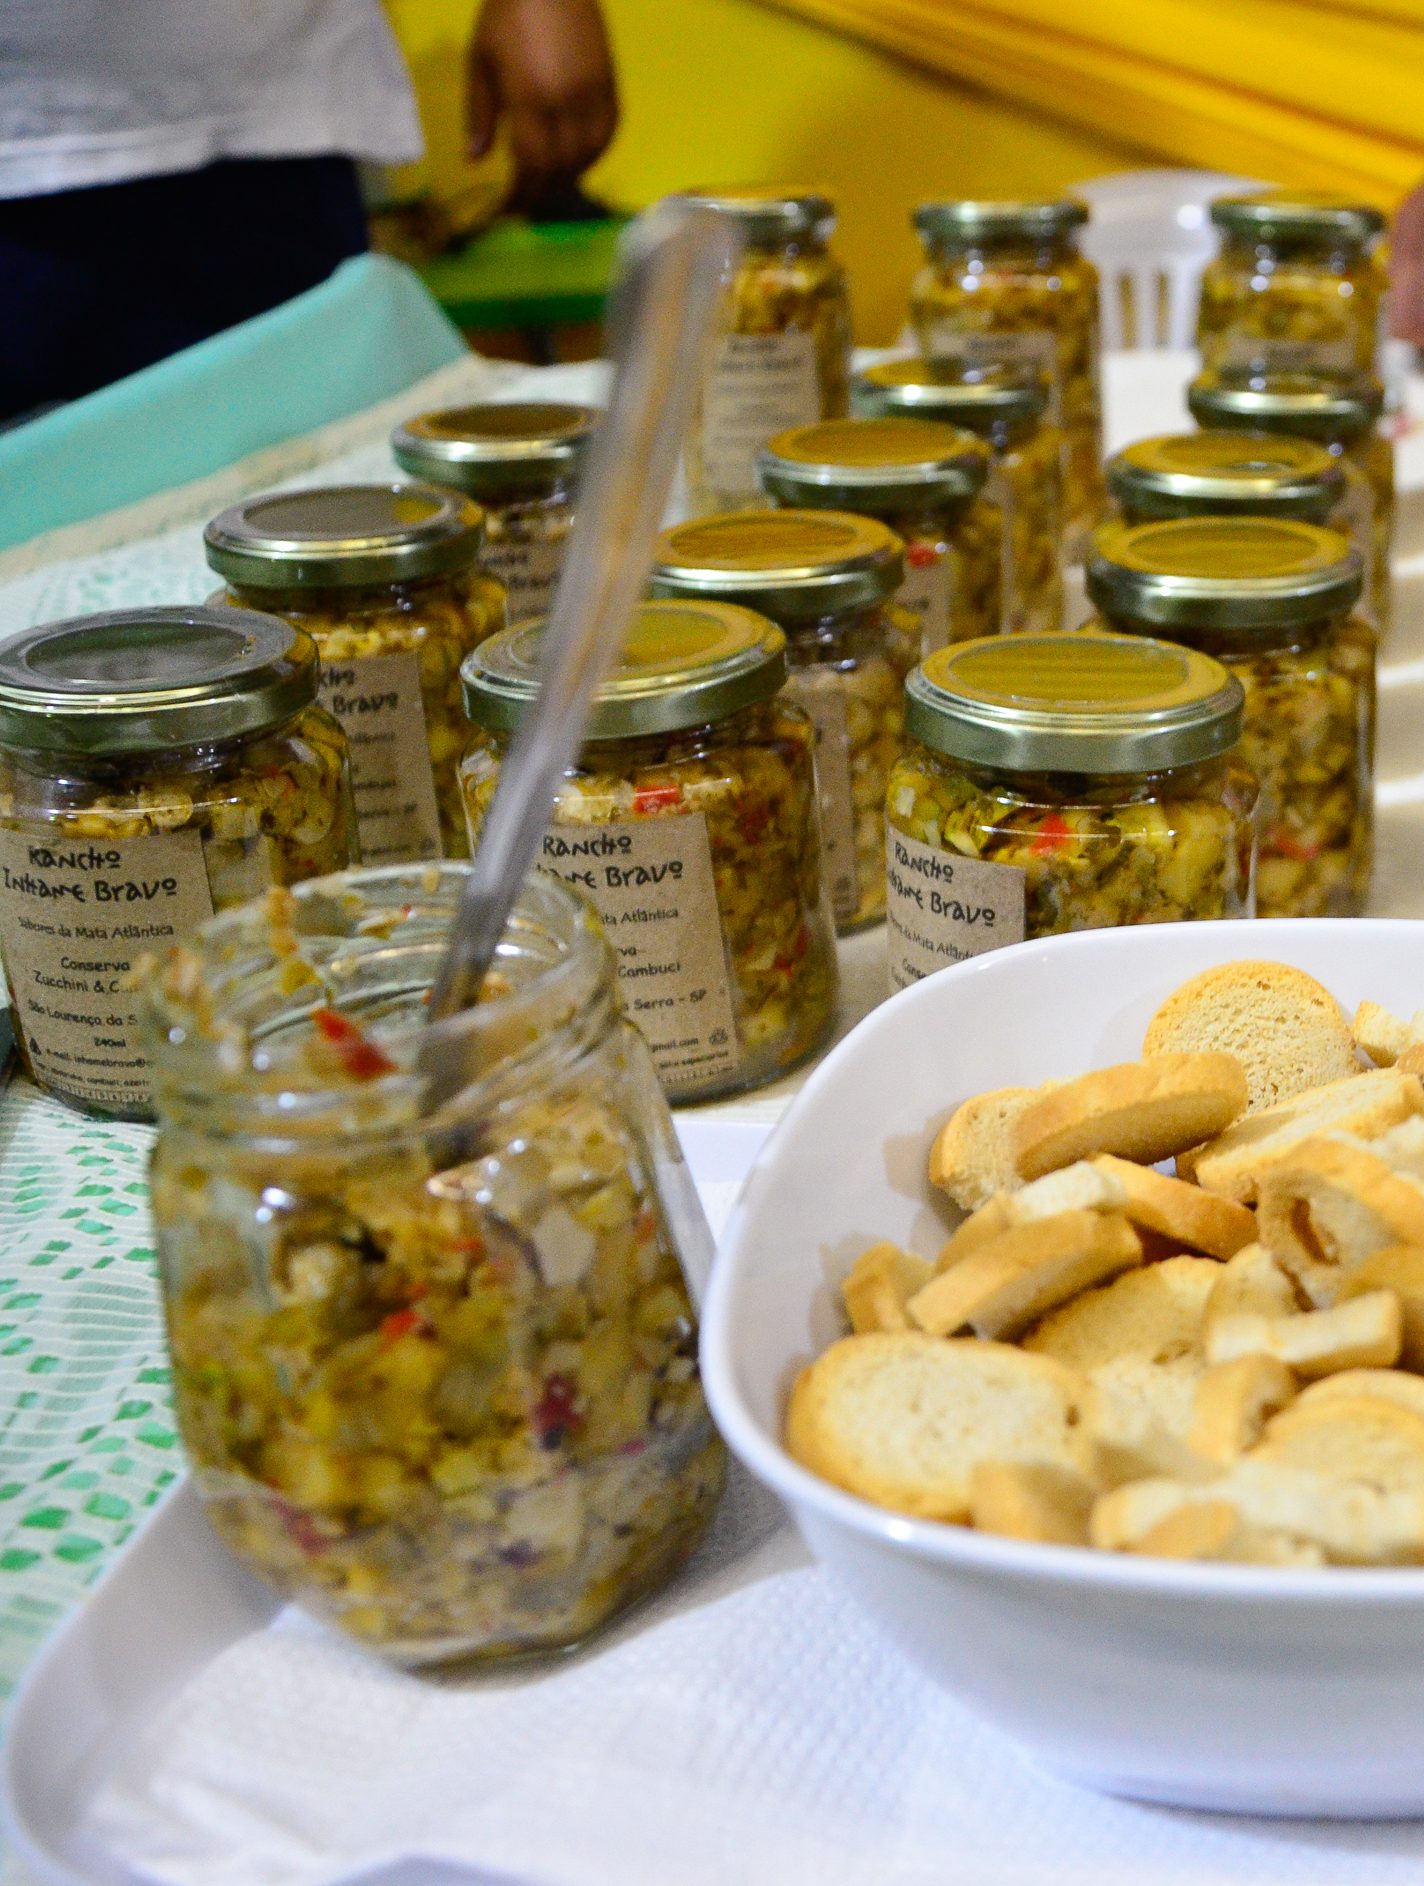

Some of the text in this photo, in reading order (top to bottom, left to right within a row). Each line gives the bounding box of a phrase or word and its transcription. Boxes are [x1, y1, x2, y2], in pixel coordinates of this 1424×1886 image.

[621, 908, 679, 924] Atlântica
[75, 927, 108, 940] Mata
[111, 924, 174, 940] Atlântica
[60, 956, 131, 972] Conserva
[33, 970, 88, 992] Zucchini
[93, 980, 105, 993] &
[634, 997, 674, 1011] Serra
[48, 1006, 102, 1026] Lourenço
[106, 1014, 122, 1026] da
